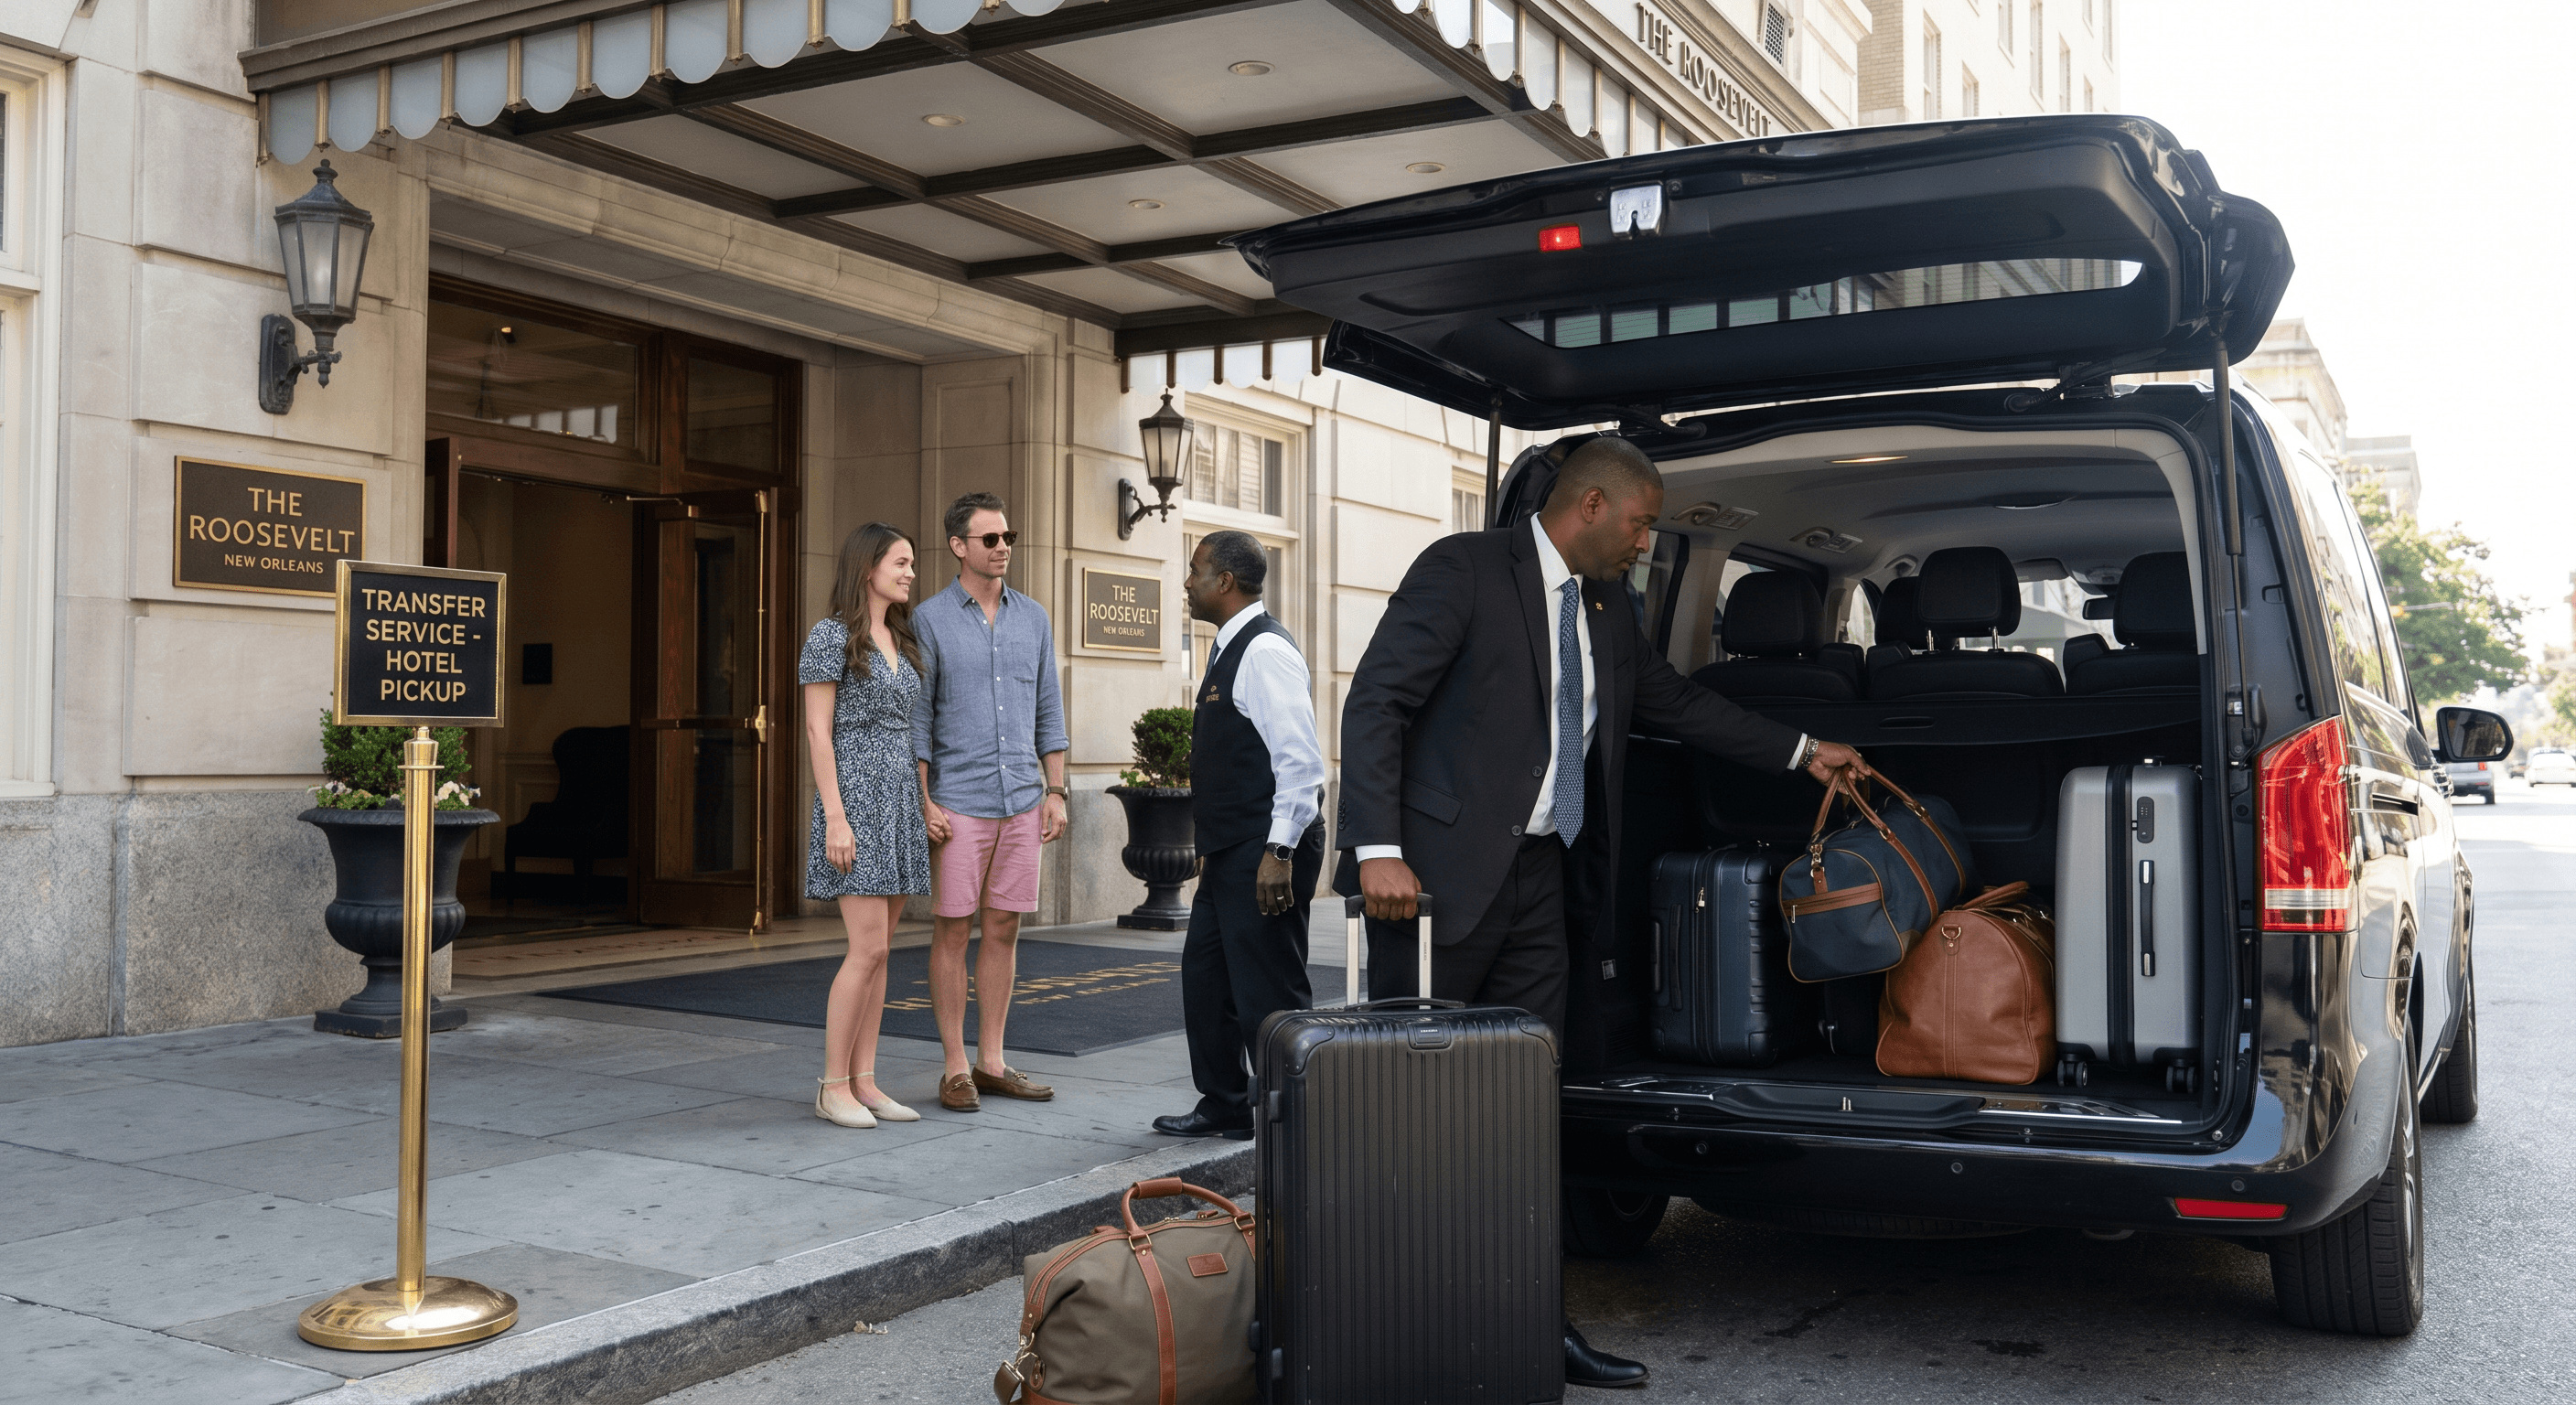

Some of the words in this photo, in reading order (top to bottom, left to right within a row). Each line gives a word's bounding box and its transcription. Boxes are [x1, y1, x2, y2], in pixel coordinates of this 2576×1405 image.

[1636, 2, 1673, 65] THE
[1680, 41, 1771, 137] ROOSEVELT
[247, 487, 303, 517] THE
[188, 514, 355, 554] ROOSEVELT
[224, 553, 256, 568] NEW
[260, 556, 324, 574] ORLEANS
[361, 588, 486, 618] TRANSFER
[1111, 585, 1136, 603] THE
[1089, 602, 1159, 625] ROOSEVELT
[365, 618, 467, 646] SERVICE
[1103, 626, 1116, 635] NEW
[1118, 627, 1145, 637] ORLEANS
[386, 649, 463, 674] HOTEL
[381, 679, 467, 702] PICKUP
